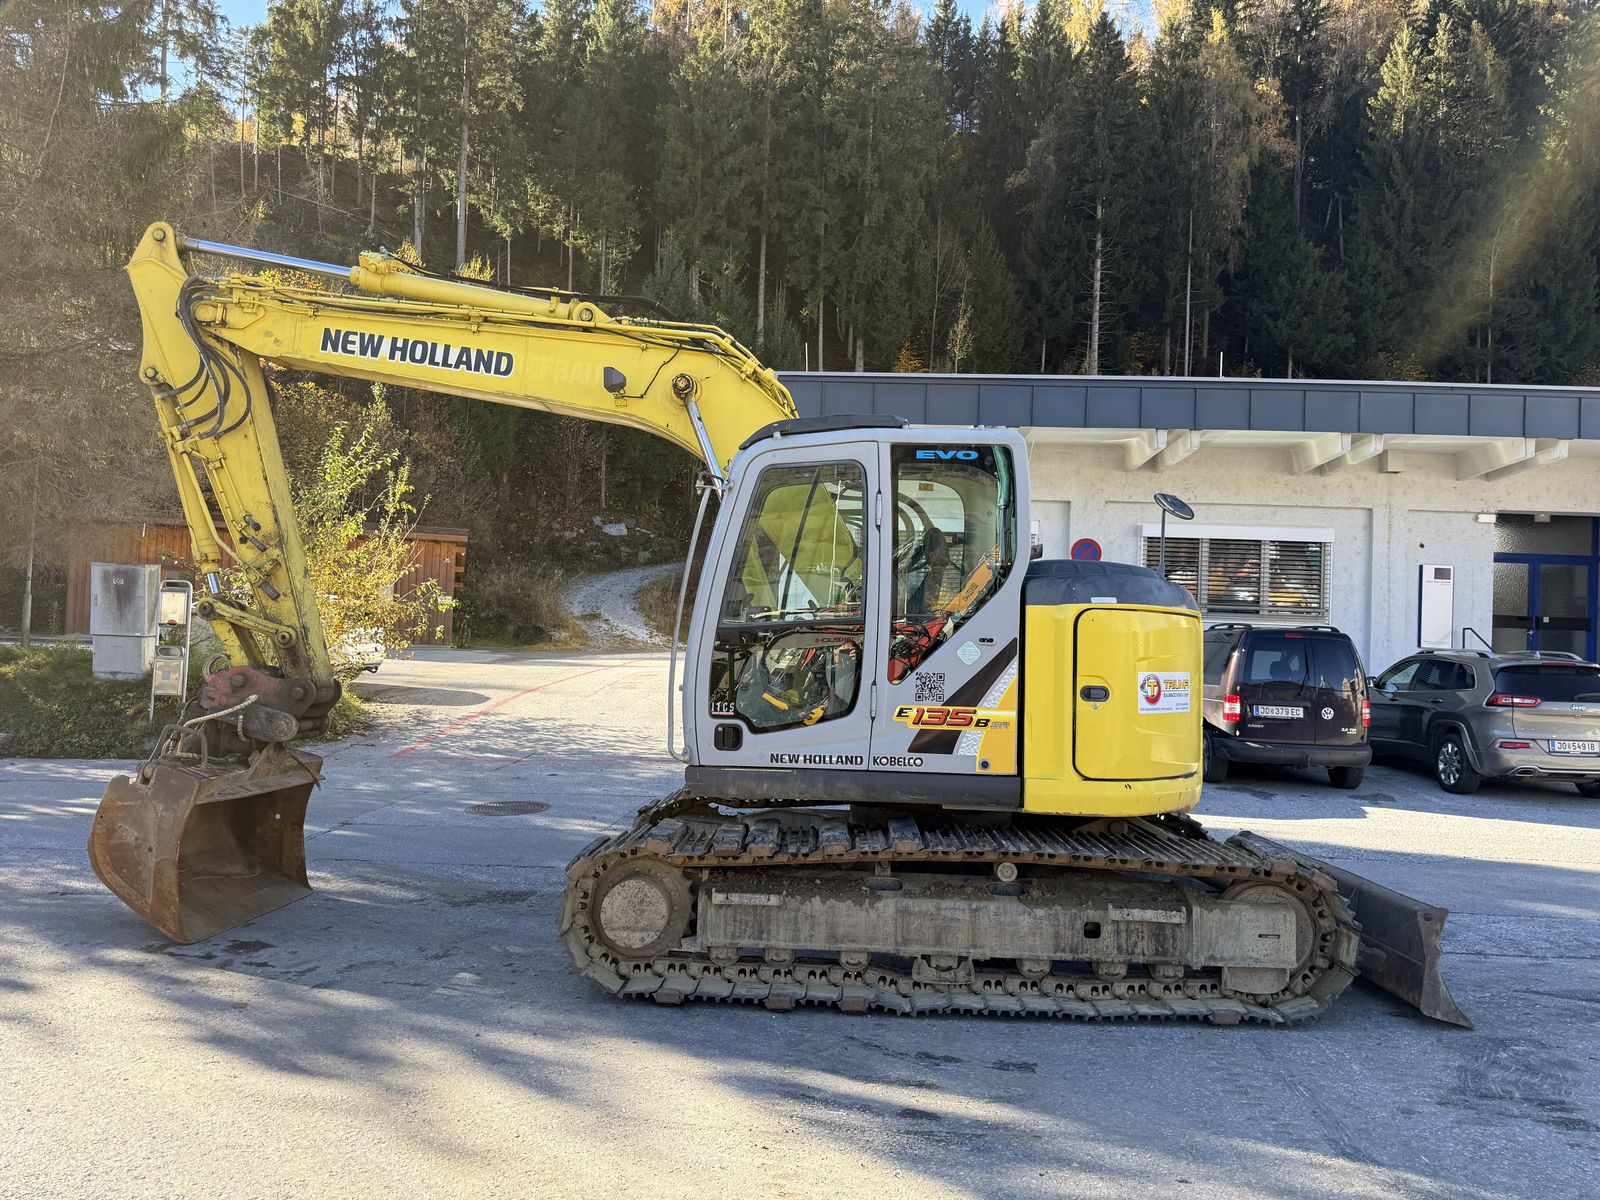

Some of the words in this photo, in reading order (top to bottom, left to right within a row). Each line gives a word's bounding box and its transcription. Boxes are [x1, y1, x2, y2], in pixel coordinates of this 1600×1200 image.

[320, 327, 385, 359] NEW
[387, 336, 514, 377] HOLLAND
[915, 449, 979, 460] EVO
[770, 753, 800, 764] NEW
[803, 754, 864, 766] HOLLAND
[873, 756, 924, 767] KOBELCO
